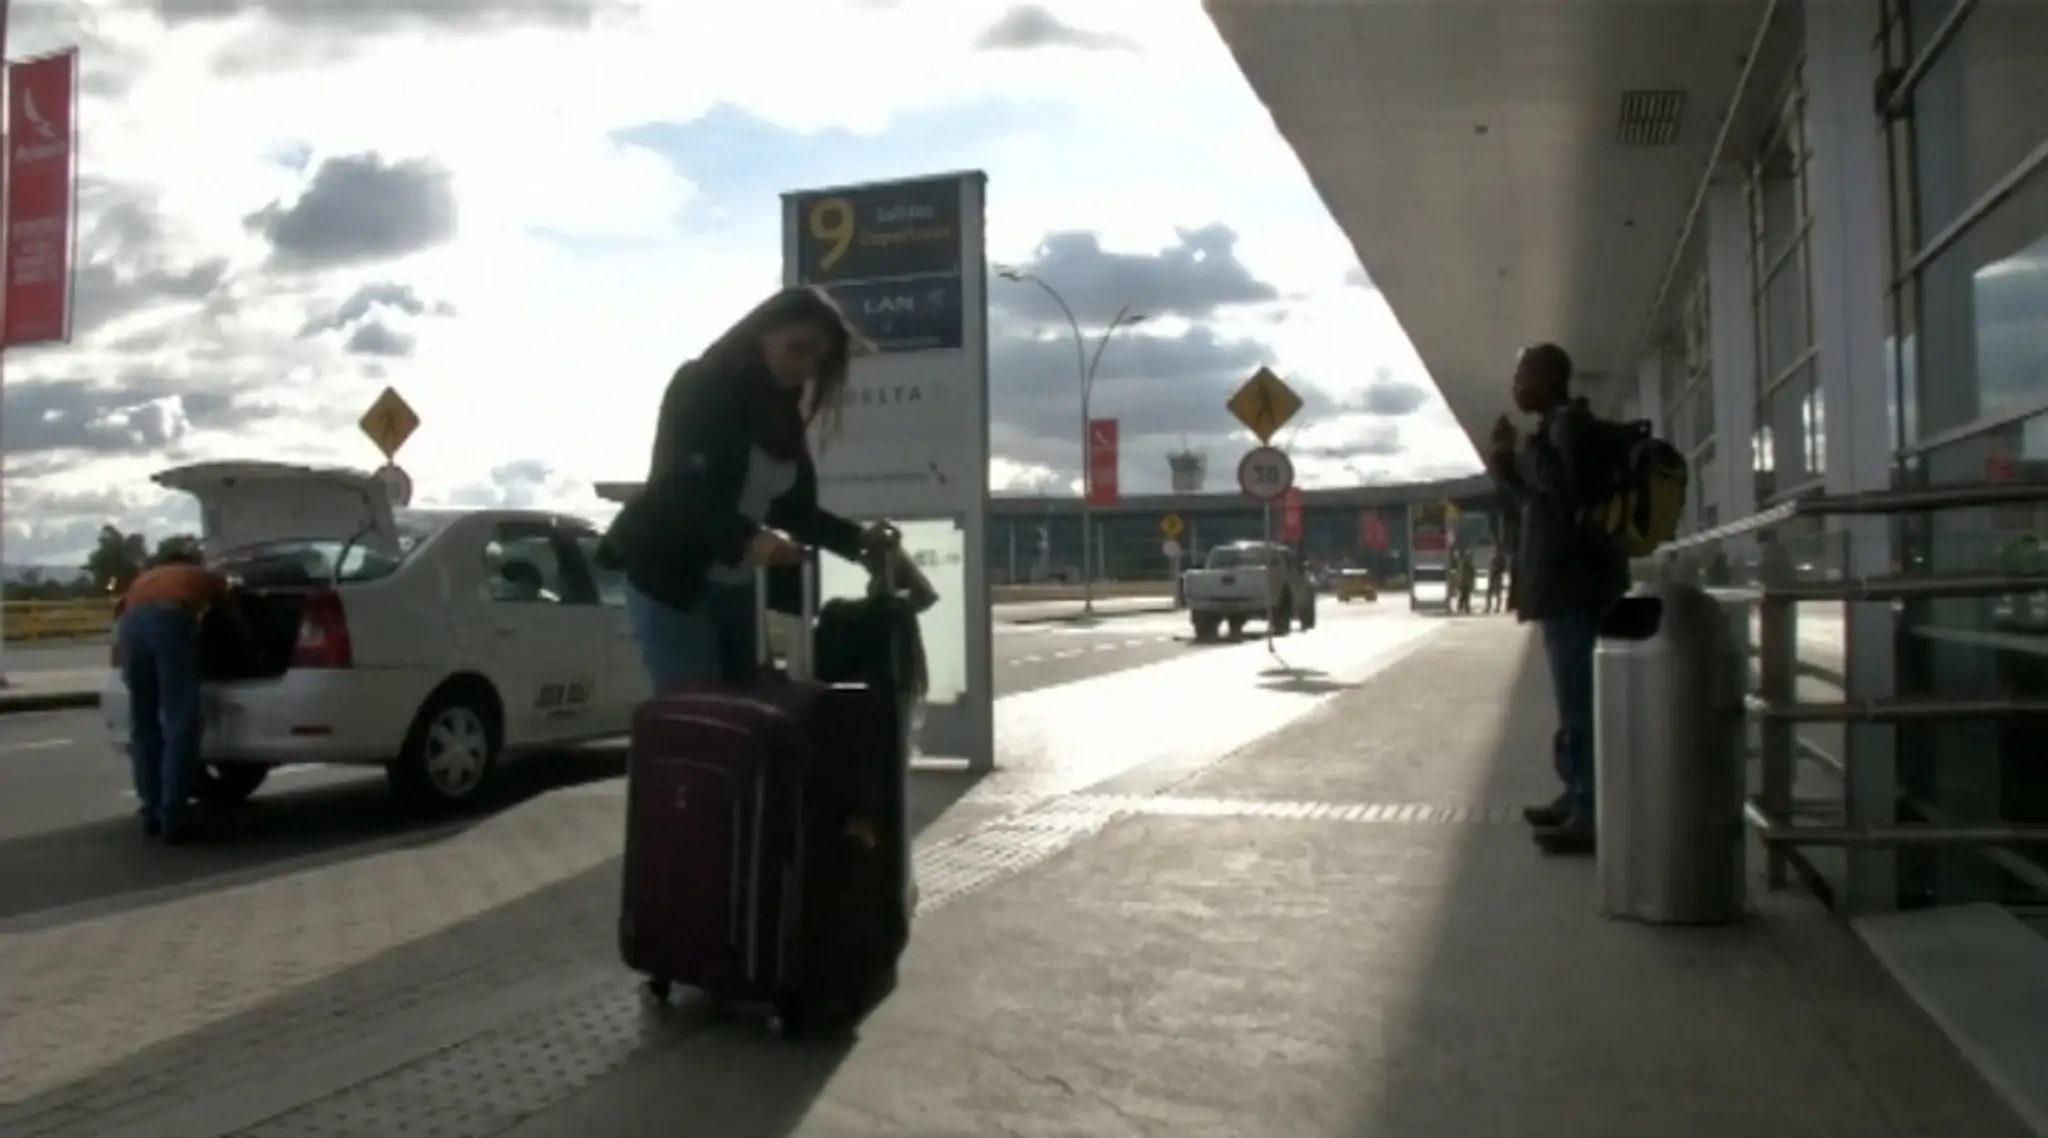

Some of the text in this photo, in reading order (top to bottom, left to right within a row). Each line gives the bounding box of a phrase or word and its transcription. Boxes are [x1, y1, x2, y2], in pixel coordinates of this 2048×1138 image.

[808, 196, 856, 271] 9
[863, 294, 915, 315] LAN
[1252, 465, 1279, 485] 30
